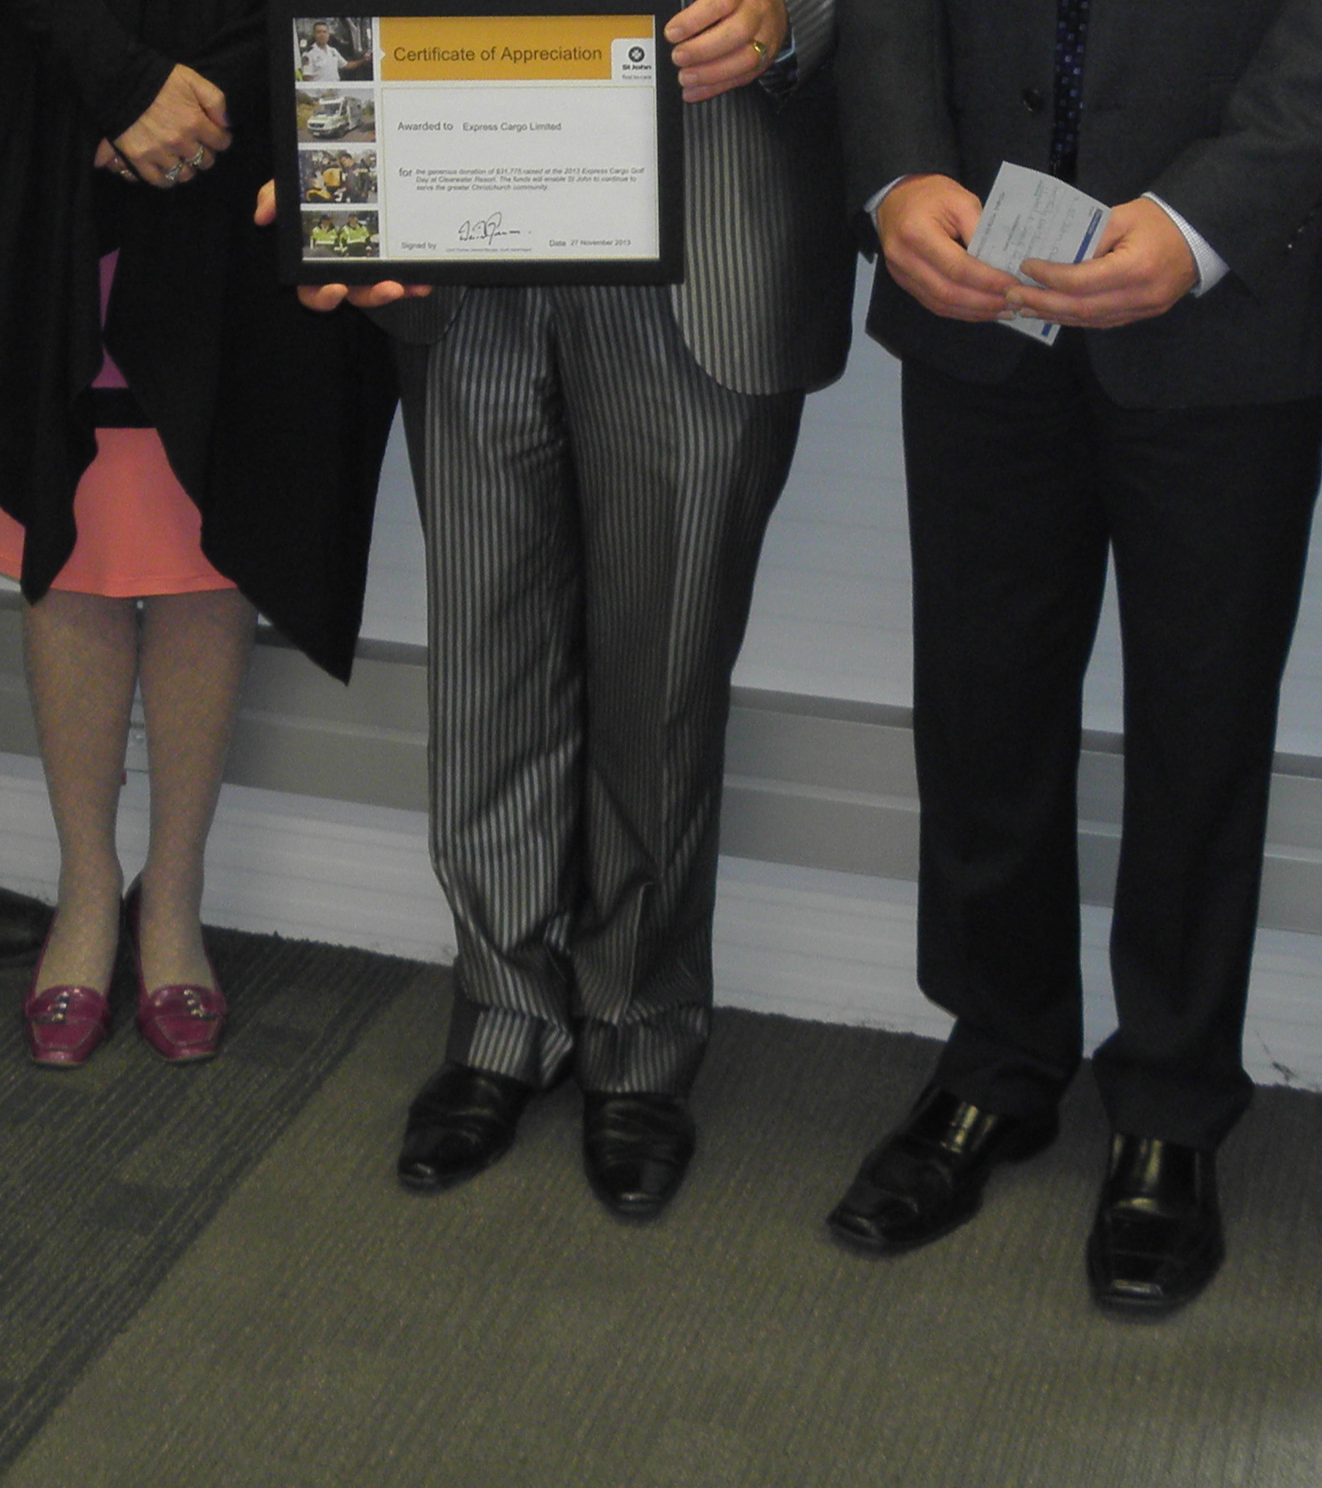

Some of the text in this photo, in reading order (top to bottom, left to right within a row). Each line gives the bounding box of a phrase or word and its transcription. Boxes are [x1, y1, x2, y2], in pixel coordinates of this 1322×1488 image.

[393, 46, 602, 64] Certificate of Appreciation
[397, 121, 562, 132] Awarded to Express Cargo Limited
[398, 167, 413, 177] for
[401, 242, 426, 250] Signed
[428, 242, 437, 250] by
[549, 239, 566, 247] Date
